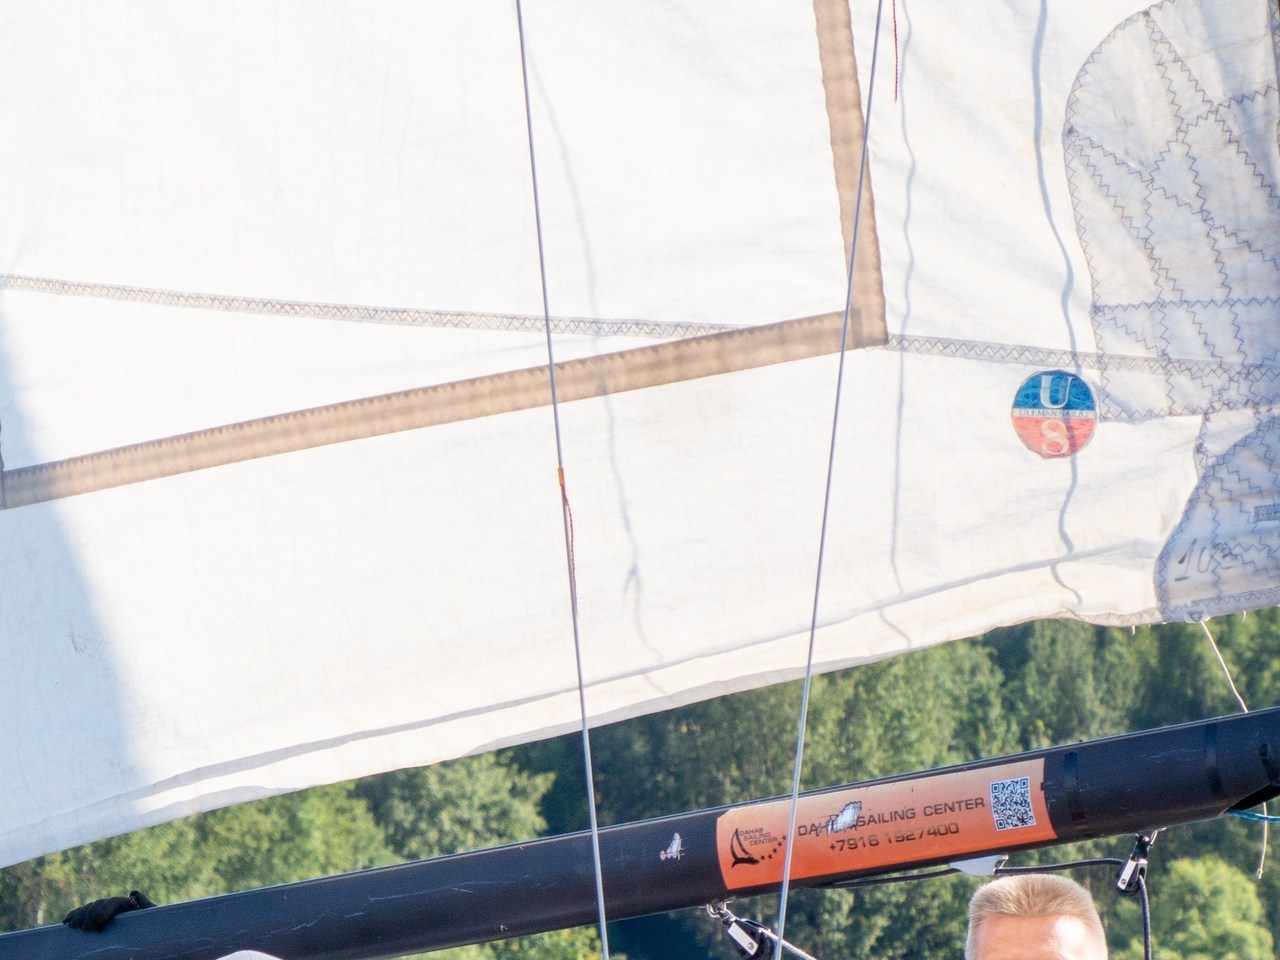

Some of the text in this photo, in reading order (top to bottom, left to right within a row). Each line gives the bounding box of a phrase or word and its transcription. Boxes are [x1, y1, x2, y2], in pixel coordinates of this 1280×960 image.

[856, 807, 916, 828] SAILING
[923, 797, 985, 817] CENTER
[739, 828, 764, 837] DAHAB
[743, 832, 772, 841] SAILING
[750, 837, 779, 846] CENTER
[830, 834, 880, 852] +7916
